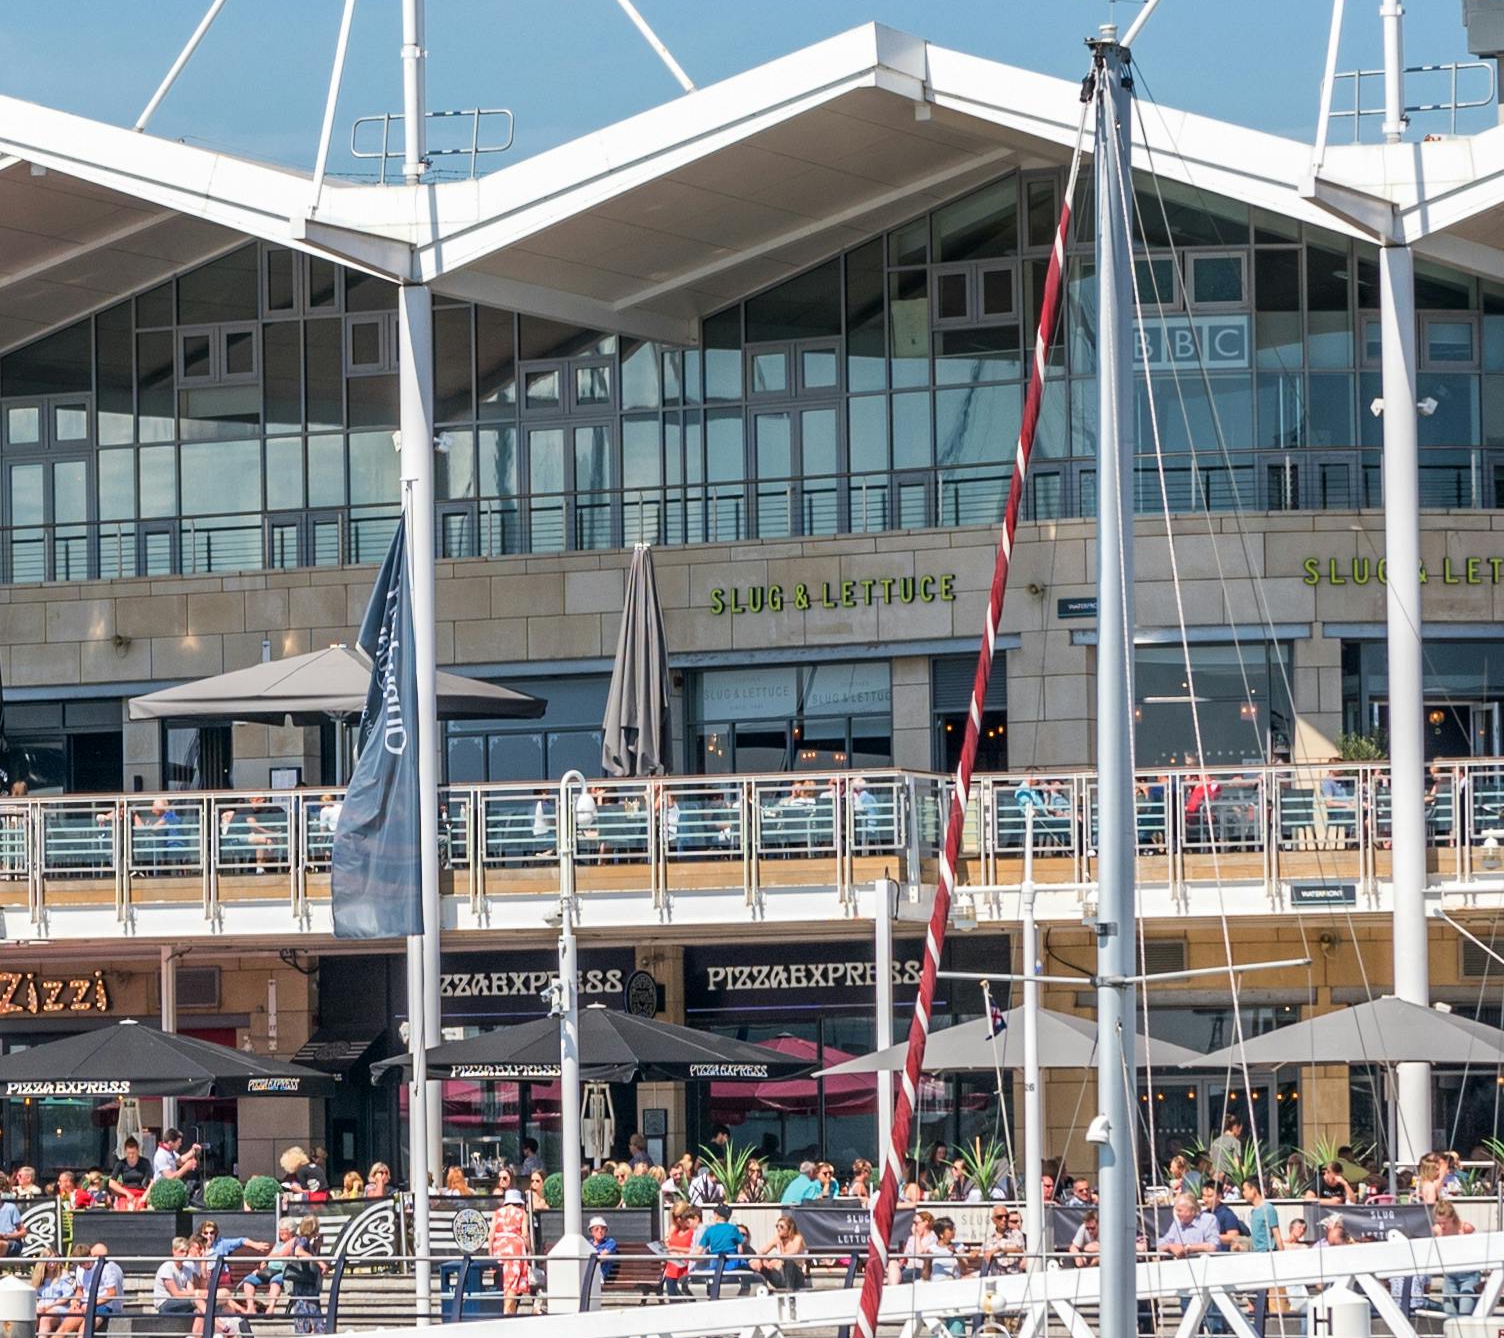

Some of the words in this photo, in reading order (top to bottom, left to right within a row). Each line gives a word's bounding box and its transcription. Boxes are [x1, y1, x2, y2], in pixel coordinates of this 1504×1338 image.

[711, 585, 783, 616] SLUG
[795, 582, 810, 610] &
[822, 575, 957, 608] LETTUCE
[450, 1064, 562, 1078] PIZZAEXPRESS
[688, 1064, 769, 1078] PIZZAEXPRESS
[6, 1080, 131, 1094] PIZZAEXPRESS
[1313, 1306, 1333, 1336] H
